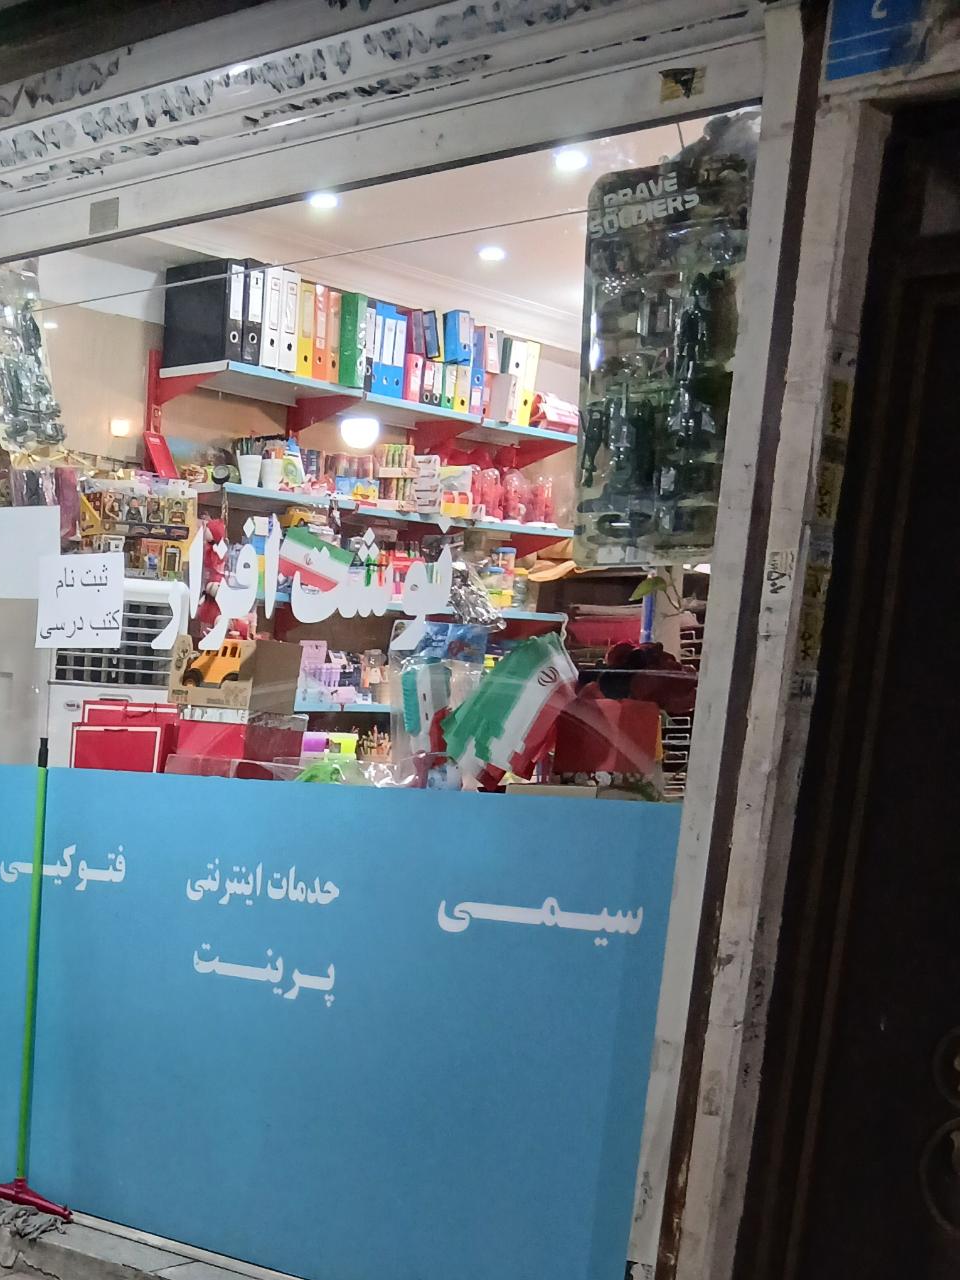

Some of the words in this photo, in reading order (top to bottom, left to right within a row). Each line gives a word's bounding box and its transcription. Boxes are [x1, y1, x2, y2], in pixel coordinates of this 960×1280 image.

[55, 567, 75, 598] نام
[80, 564, 108, 593] ثبت
[40, 616, 84, 639] درسی
[89, 609, 120, 637] کتب
[186, 858, 263, 906] اینترنتی
[437, 896, 644, 947] سیمی
[193, 942, 336, 1008] پرینت
